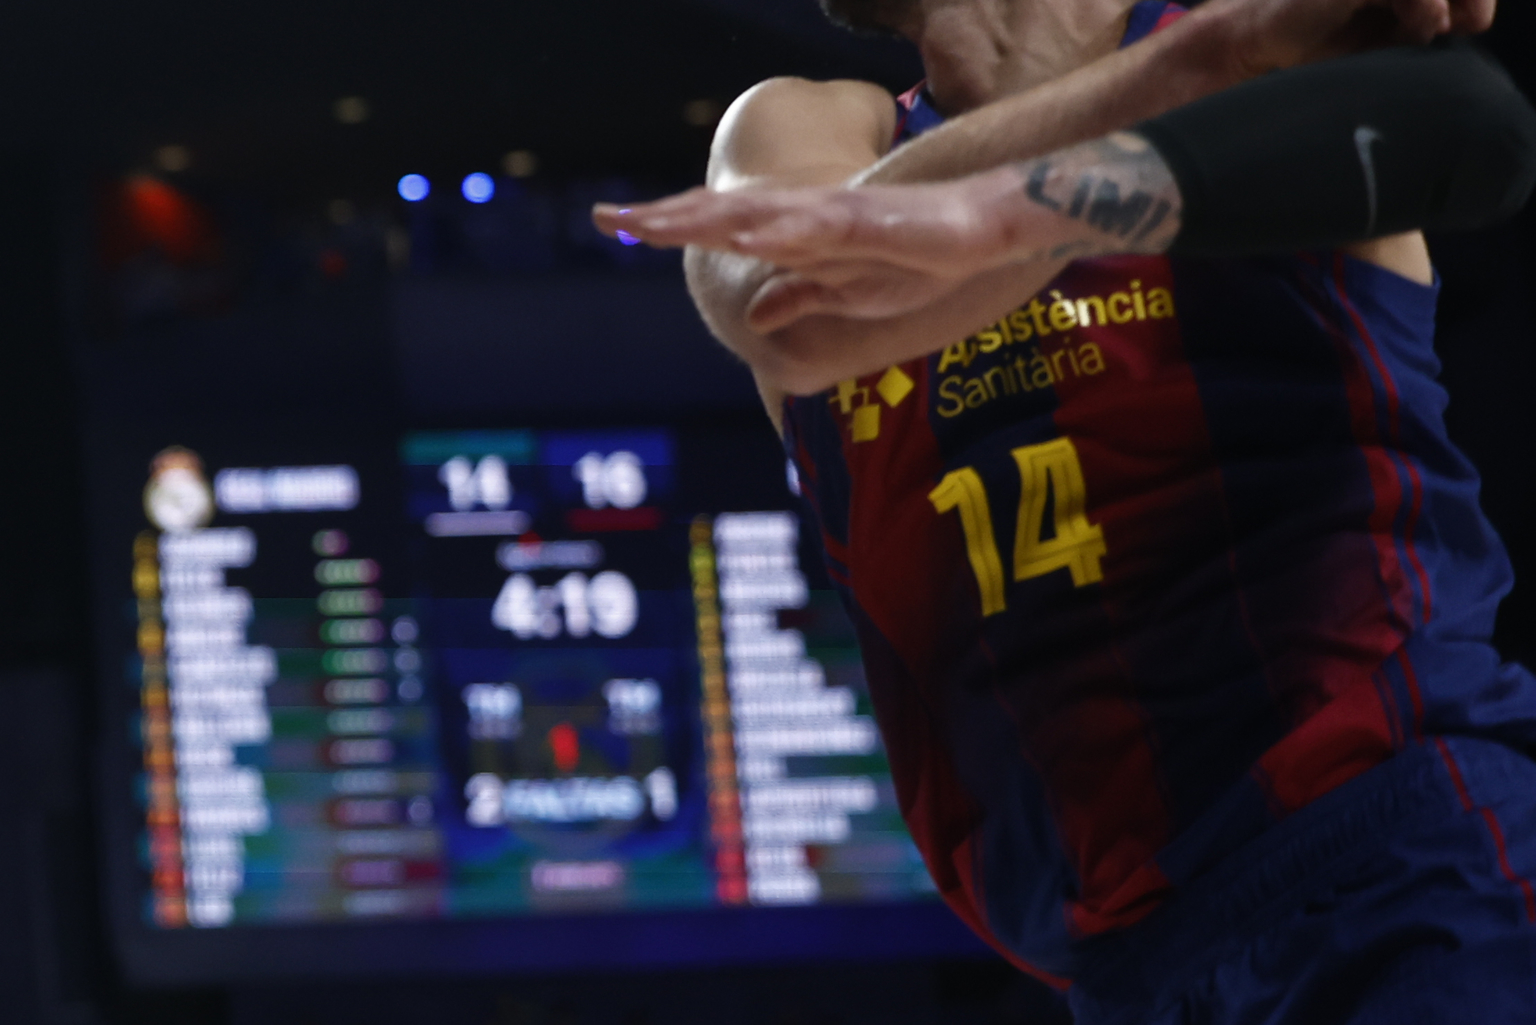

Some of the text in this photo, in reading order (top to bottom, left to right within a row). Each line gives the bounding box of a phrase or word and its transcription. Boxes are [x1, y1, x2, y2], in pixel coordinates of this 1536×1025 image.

[937, 279, 1175, 373] Asistència
[937, 337, 1105, 418] Sanitària
[438, 455, 512, 510] 14
[573, 451, 646, 509] 16
[928, 437, 1107, 617] 14
[492, 571, 638, 639] 4:19
[645, 766, 677, 820] 1
